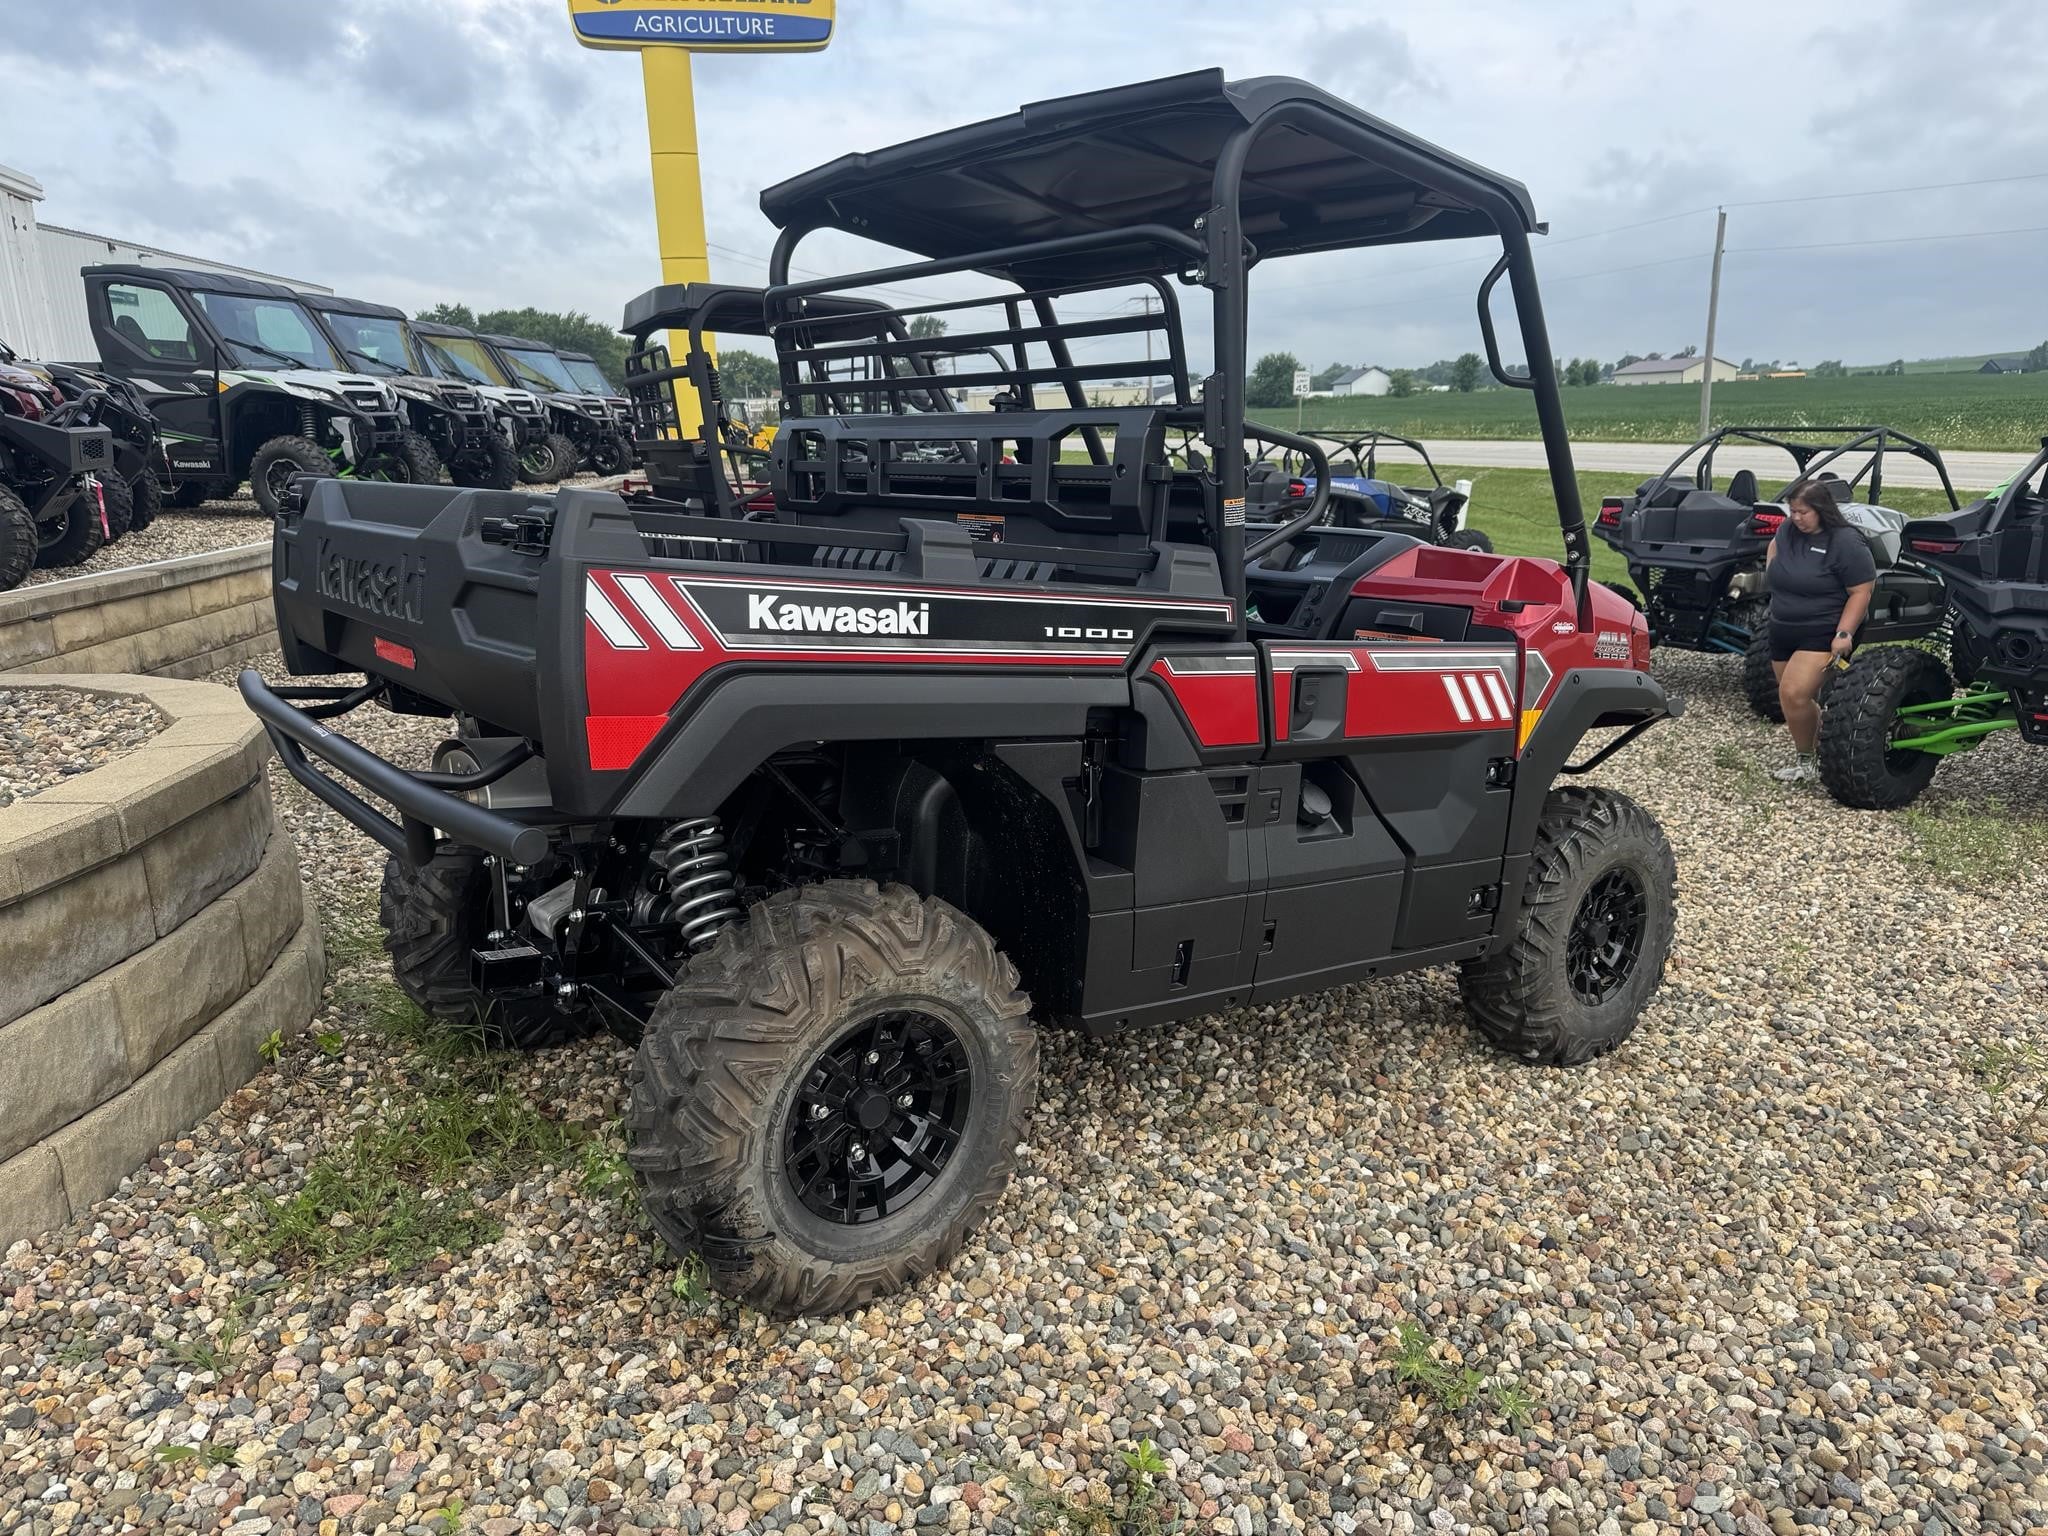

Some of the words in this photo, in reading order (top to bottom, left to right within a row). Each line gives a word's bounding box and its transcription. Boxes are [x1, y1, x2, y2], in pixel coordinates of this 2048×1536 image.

[634, 15, 775, 35] AGRICULTURE
[173, 460, 211, 469] Kawasaki
[316, 537, 426, 624] Kawasaki
[748, 594, 930, 634] Kawasaki
[1044, 626, 1134, 640] 1000
